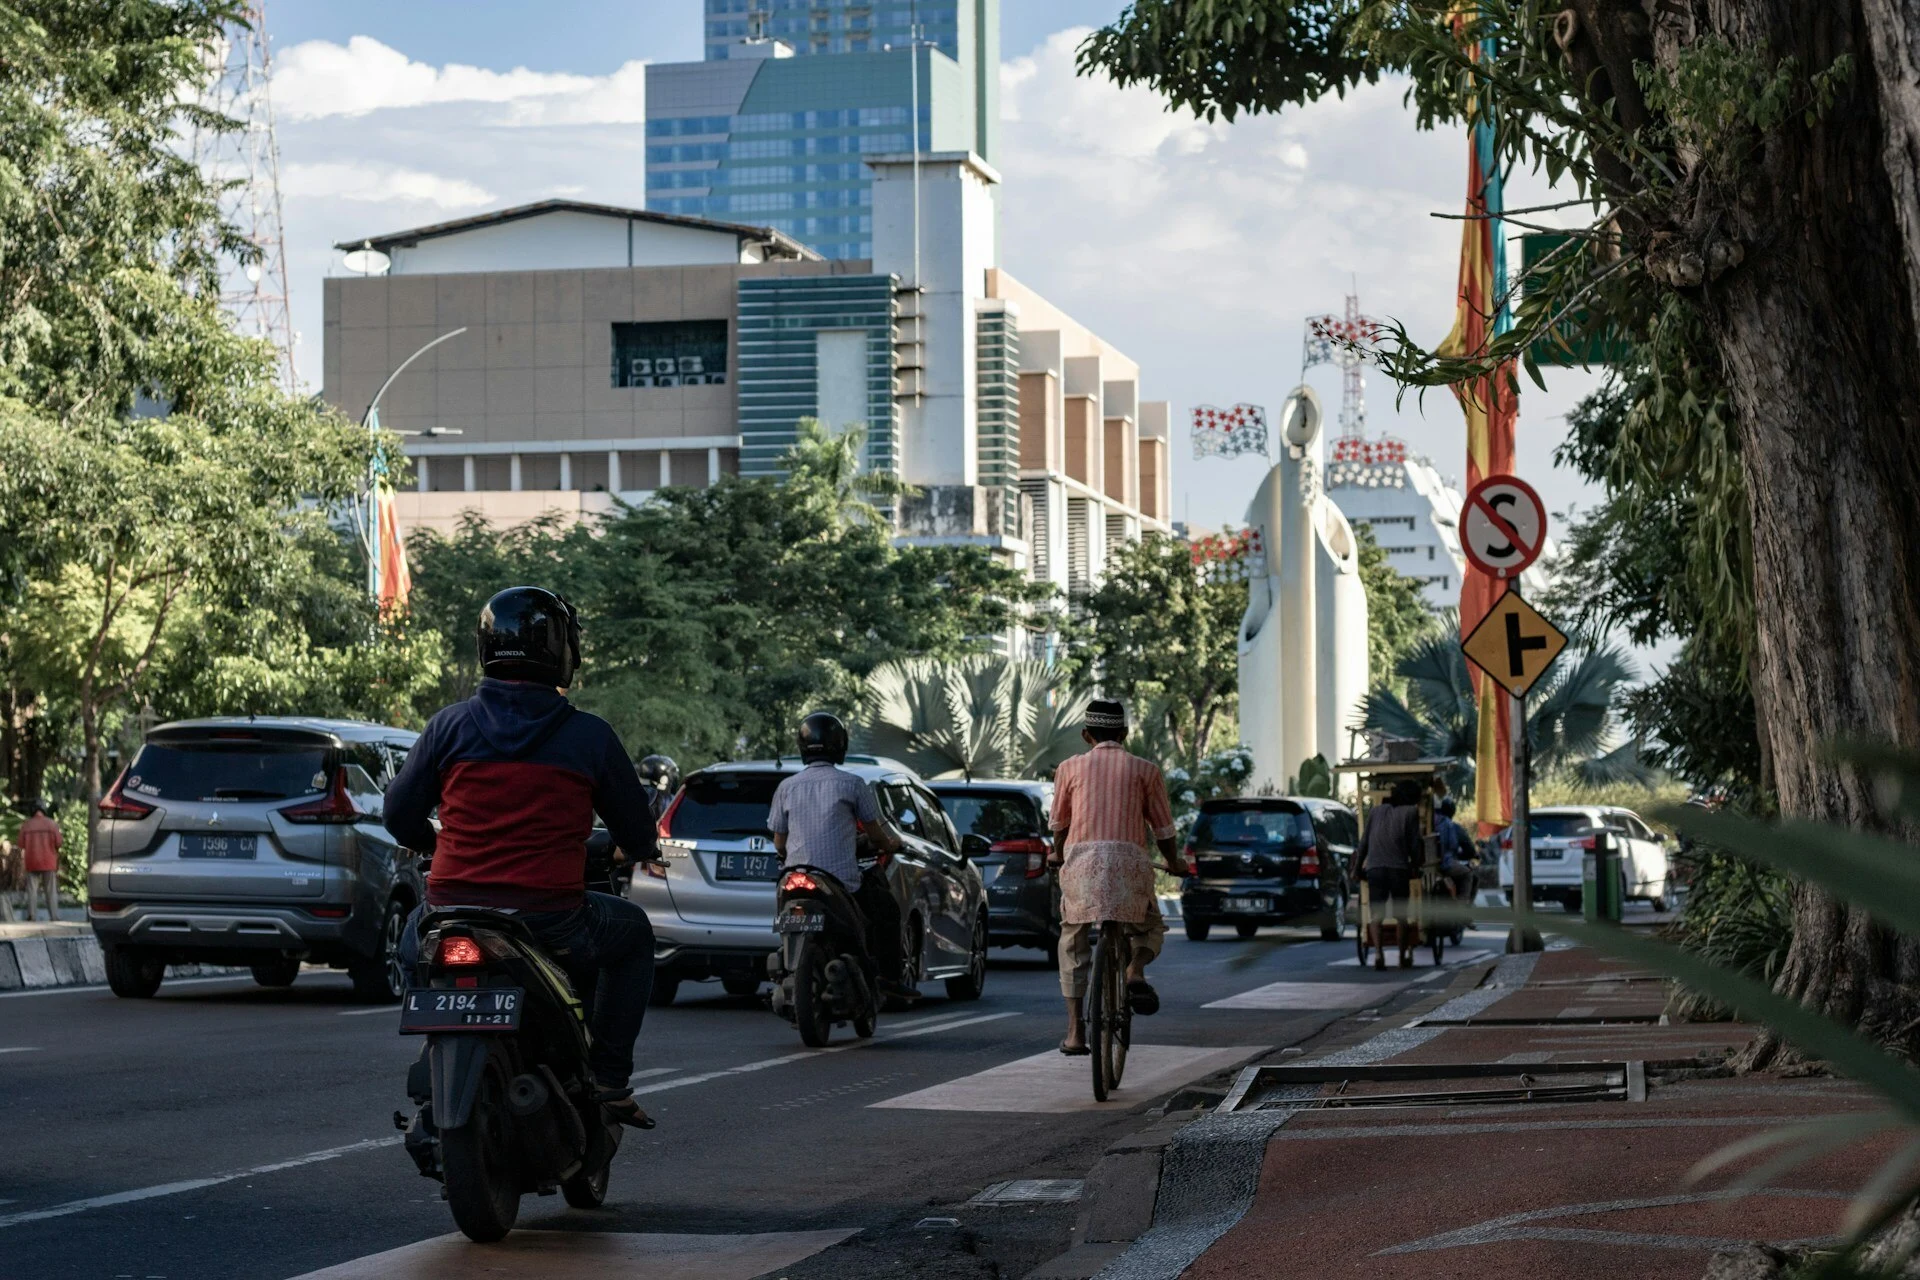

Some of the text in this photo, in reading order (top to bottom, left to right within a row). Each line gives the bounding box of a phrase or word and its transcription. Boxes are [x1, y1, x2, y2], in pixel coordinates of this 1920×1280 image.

[1486, 493, 1519, 558] S
[180, 836, 254, 851] L 1596 CX
[721, 855, 734, 869] AE
[743, 855, 769, 870] 1757
[811, 914, 824, 923] AY
[409, 994, 516, 1011] L 2194 VG
[466, 1014, 511, 1024] 11-21
